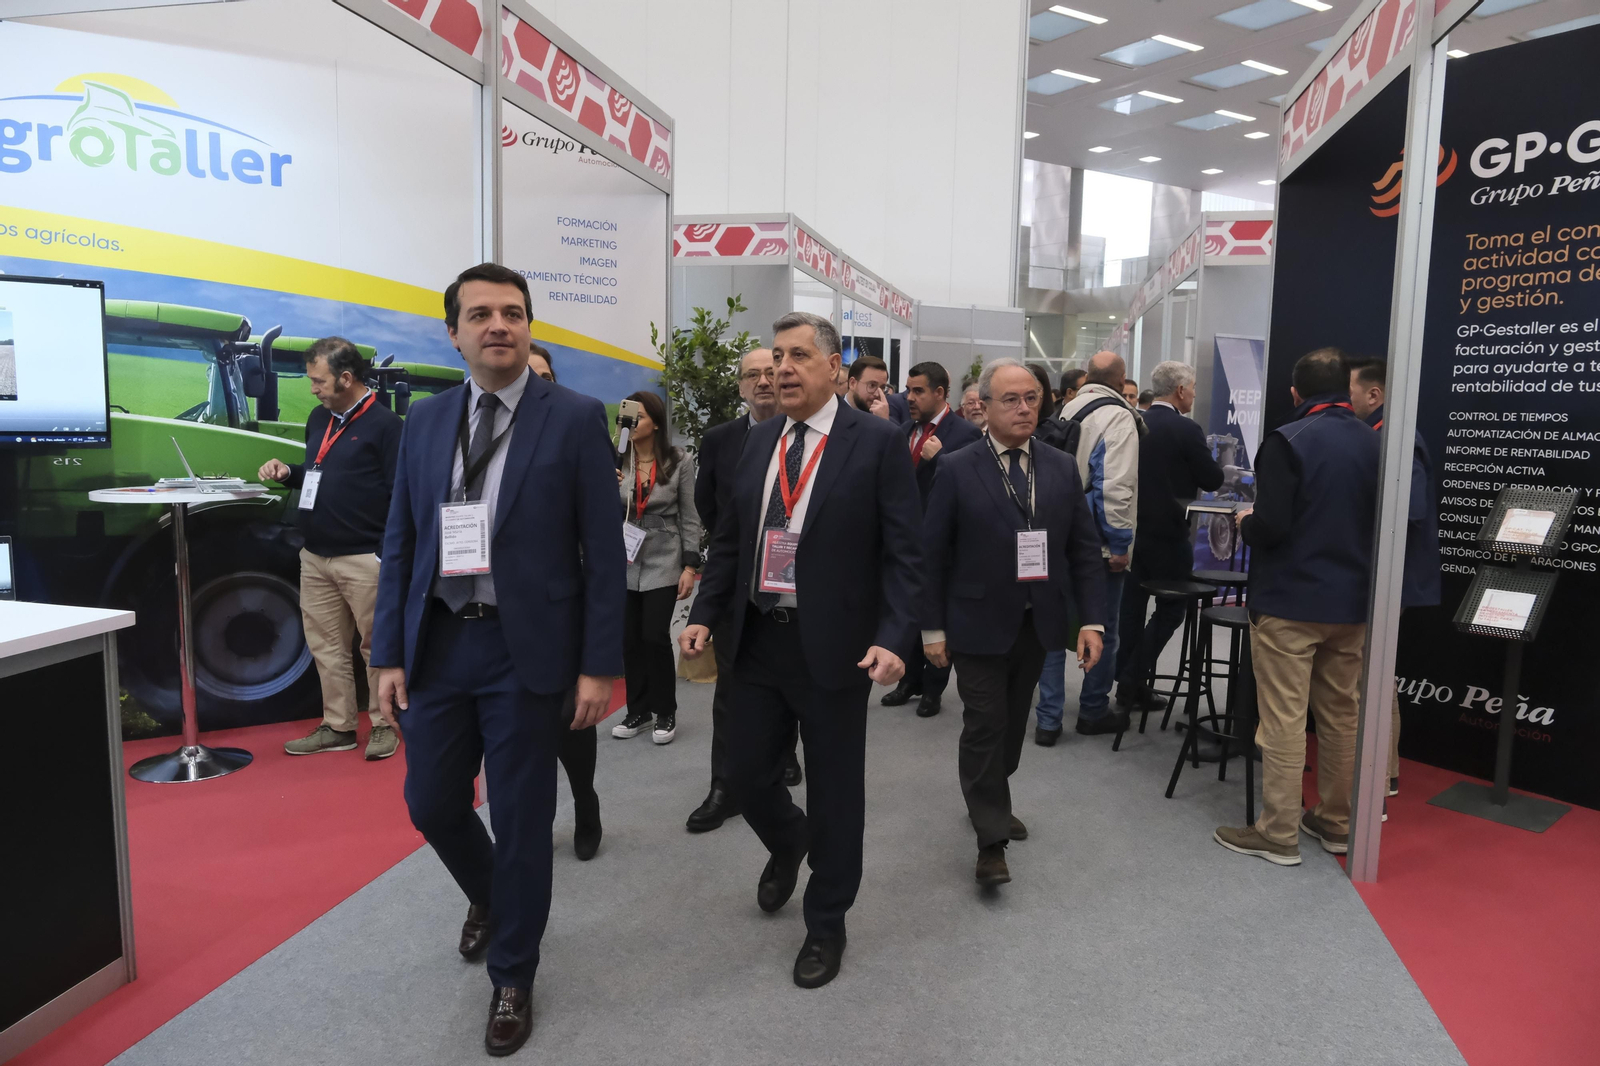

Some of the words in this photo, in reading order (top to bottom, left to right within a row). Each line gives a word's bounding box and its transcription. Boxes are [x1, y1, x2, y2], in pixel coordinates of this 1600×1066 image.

[522, 131, 575, 154] Grupo
[578, 157, 622, 168] Automoci
[1470, 183, 1544, 206] Grupo
[557, 216, 618, 232] FORMACIÓN
[25, 228, 124, 252] agrícolas.
[561, 236, 618, 250] MARKETING
[1466, 231, 1524, 251] Toma
[1531, 225, 1551, 244] el
[579, 257, 618, 269] IMAGEN
[1463, 244, 1570, 271] actividad
[573, 273, 618, 287] TÉCNICO
[1461, 269, 1572, 294] programa
[548, 291, 618, 305] RENTABILIDAD
[1459, 298, 1471, 314] y
[1477, 288, 1564, 313] gestión.
[1559, 322, 1579, 333] es
[1583, 318, 1599, 332] el
[1455, 341, 1545, 356] facturación
[1549, 343, 1559, 357] y
[1563, 340, 1600, 356] gest
[1453, 364, 1490, 377] para
[1493, 360, 1569, 377] ayudarte
[1573, 362, 1585, 372] a
[1451, 380, 1547, 393] rentabilidad
[1550, 379, 1574, 393] de
[1229, 389, 1262, 405] KEEP
[1449, 412, 1500, 421] CONTROL
[1502, 412, 1518, 422] DE
[1520, 413, 1569, 423] TIEMPOS
[1447, 428, 1541, 440] AUTOMATIZACIÓN
[1543, 431, 1560, 441] DE
[1561, 431, 1600, 442] ALMAC
[1446, 445, 1491, 456] INFORME
[1493, 446, 1508, 457] DE
[1511, 448, 1591, 460] RENTABILIDAD
[1444, 462, 1504, 475] RECEPCIÓN
[1506, 466, 1546, 476] ACTIVA
[1442, 479, 1491, 491] ORDENES
[1440, 496, 1478, 508] AVISOS
[1479, 498, 1494, 509] DE
[1438, 530, 1476, 541] ENLACE
[1574, 524, 1600, 535] MAN
[1439, 546, 1492, 560] HISTÓRICO
[1494, 552, 1509, 562] DE
[1440, 563, 1477, 575] GENDA
[1397, 676, 1453, 705] upo
[1458, 712, 1552, 743] Autoción
